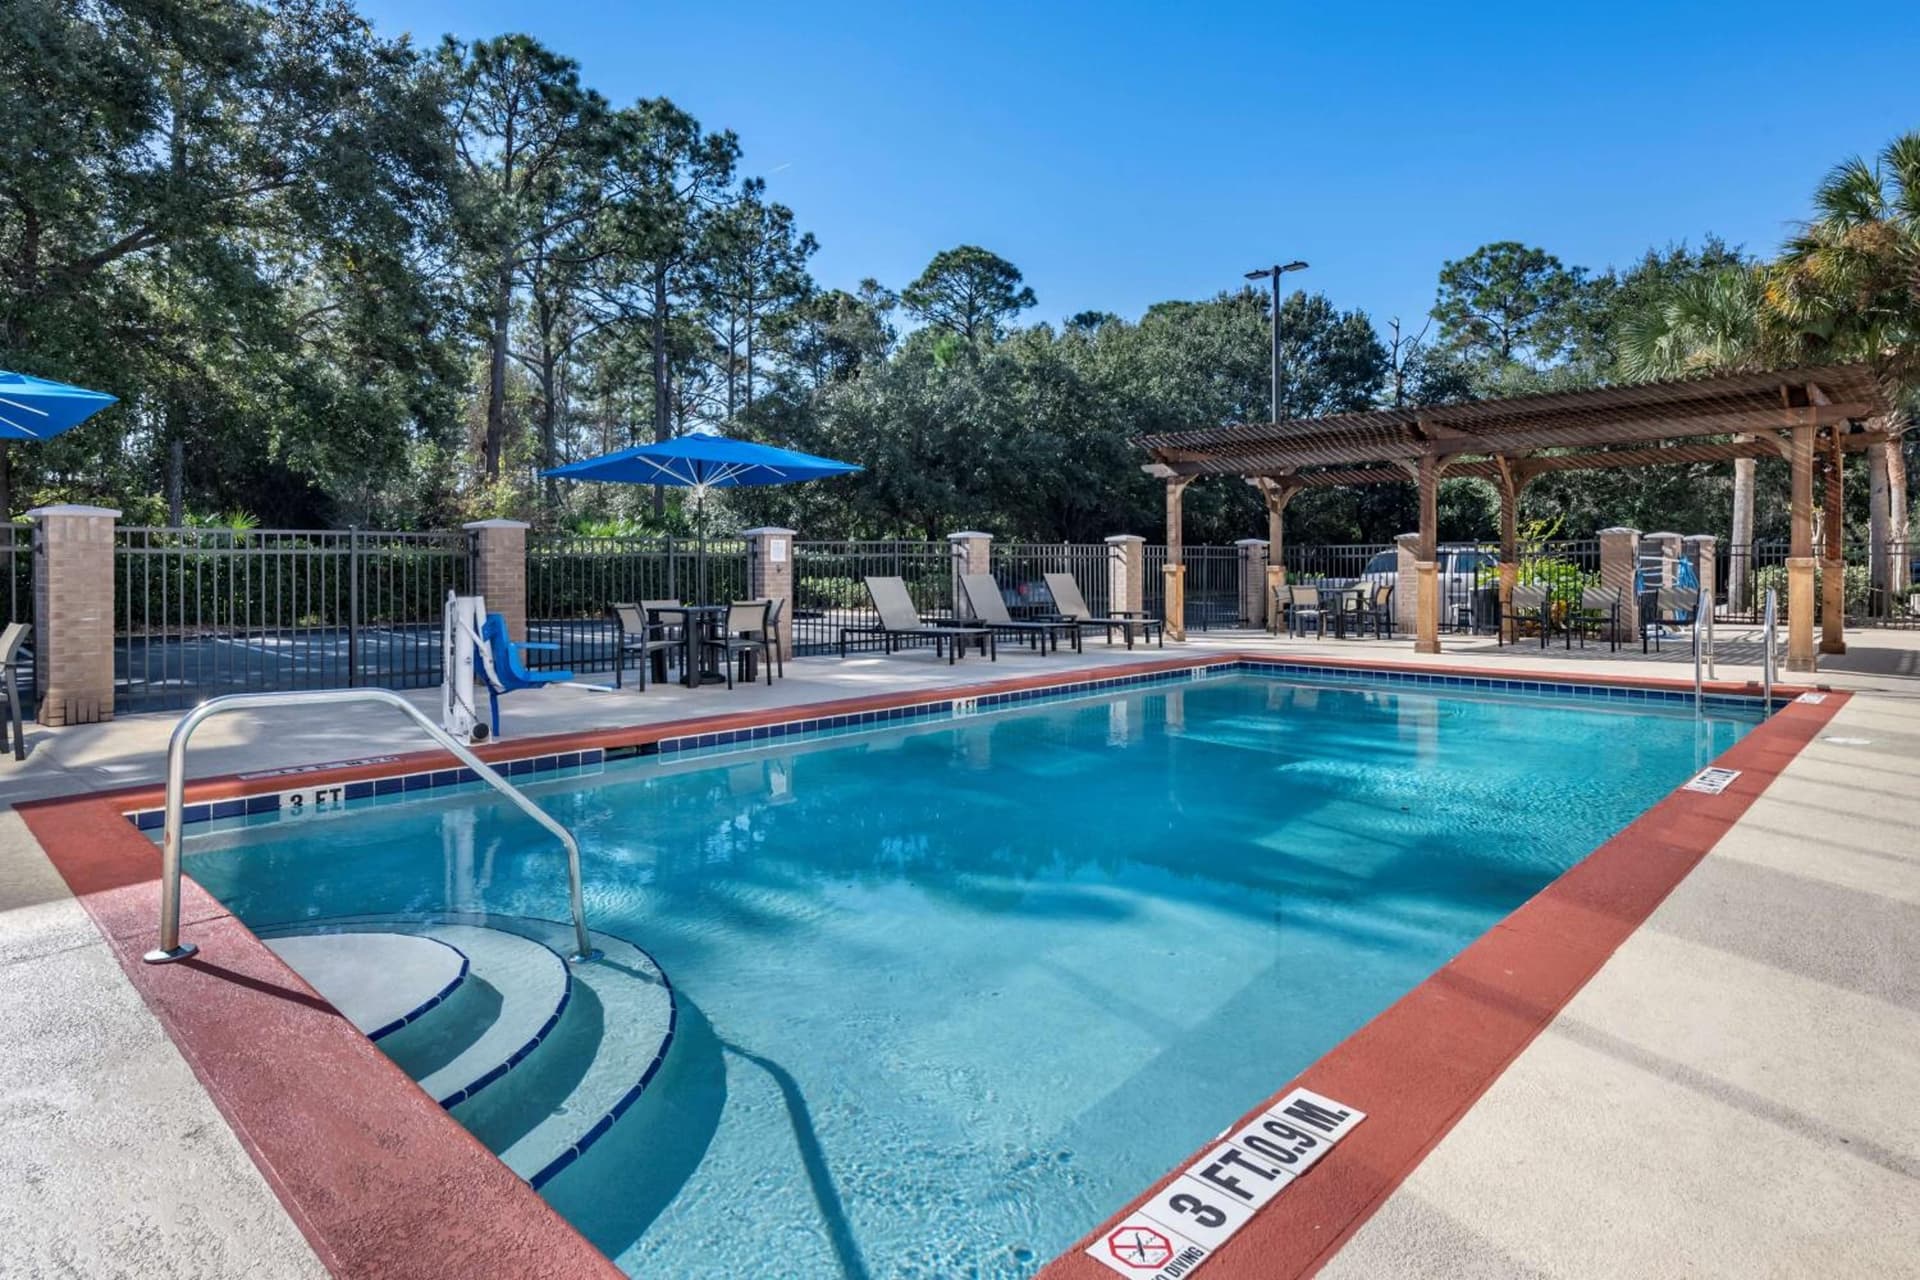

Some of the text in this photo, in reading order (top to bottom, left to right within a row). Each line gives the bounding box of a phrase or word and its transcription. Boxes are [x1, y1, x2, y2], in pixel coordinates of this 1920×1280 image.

[290, 788, 342, 808] 3 FT
[1169, 1192, 1227, 1228] 3
[1243, 1120, 1318, 1165] 0.9
[1283, 1098, 1350, 1132] M.
[1164, 1246, 1205, 1278] DIVING
